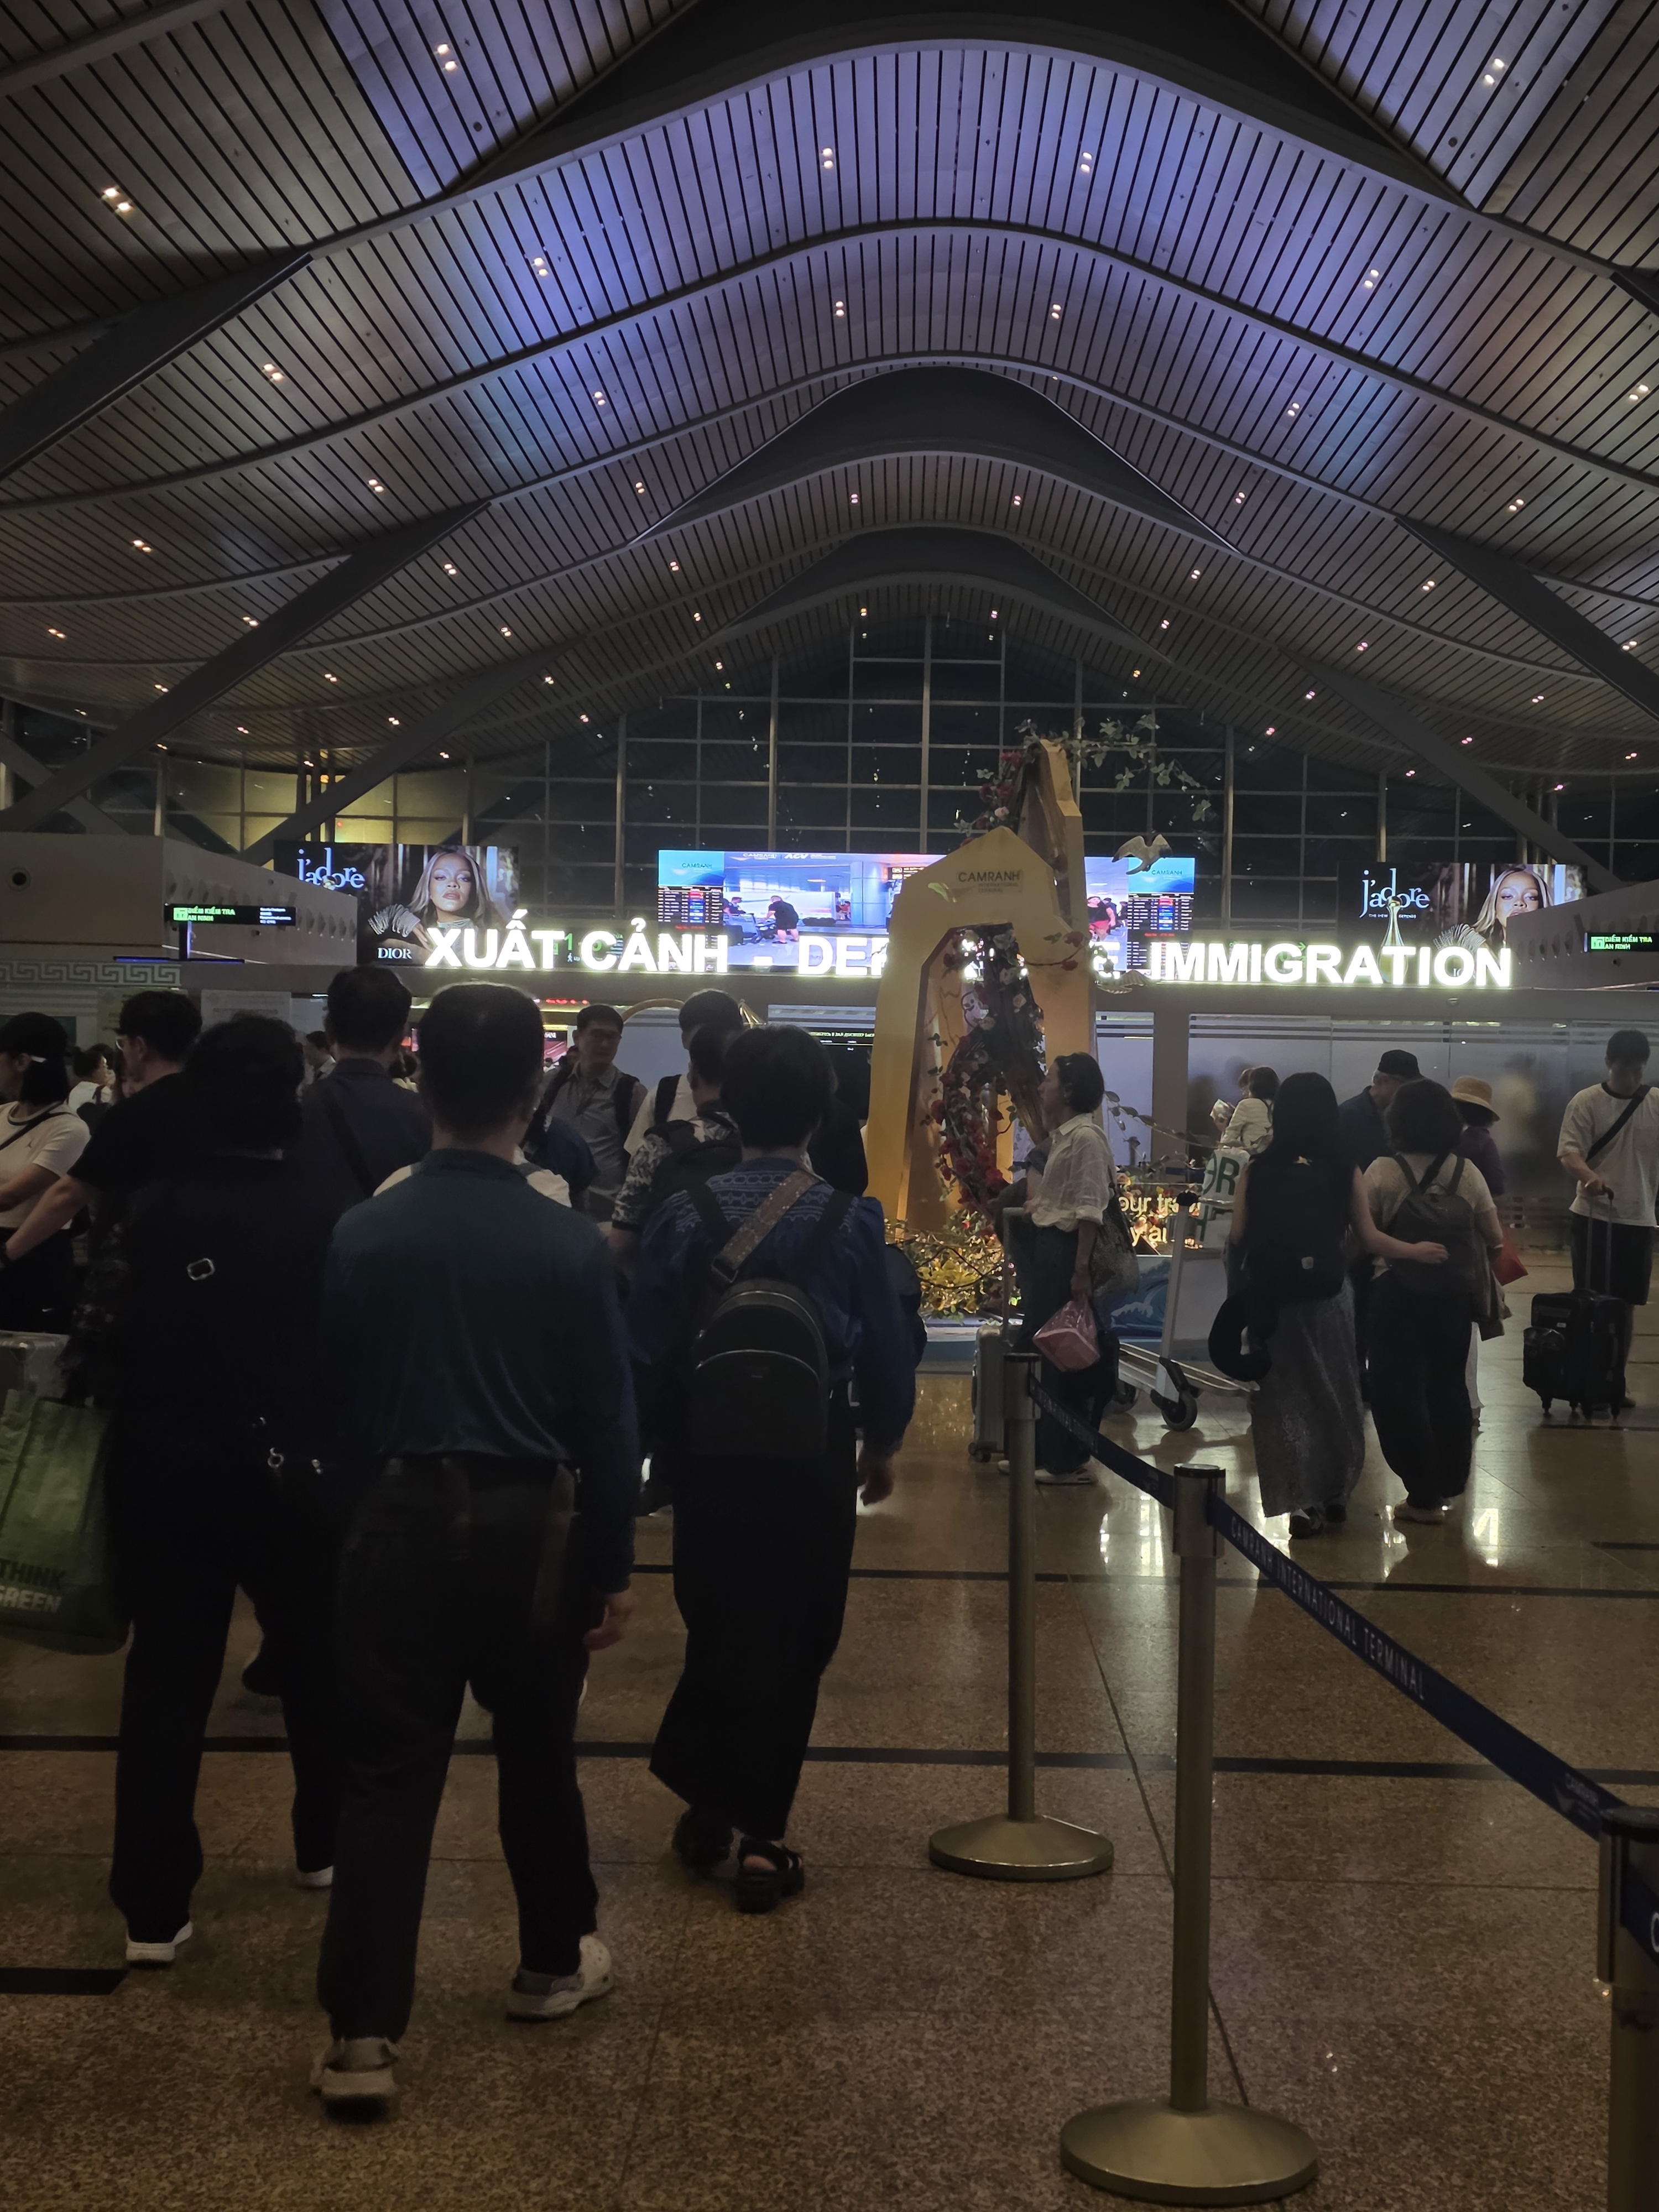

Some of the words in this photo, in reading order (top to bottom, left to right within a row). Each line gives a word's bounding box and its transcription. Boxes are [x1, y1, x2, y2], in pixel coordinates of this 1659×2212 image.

[958, 871, 1020, 883] CAMRANH
[378, 947, 412, 959] DIOR
[425, 909, 565, 969] XUẤT
[581, 917, 728, 973] CẢNH
[1151, 941, 1511, 987] IMMIGRATION
[0, 1559, 66, 1590] THINK
[1231, 1516, 1272, 1573] CAMRANH
[1277, 1556, 1357, 1646] INTERNATIONAL
[1364, 1627, 1424, 1701] TERMINAL
